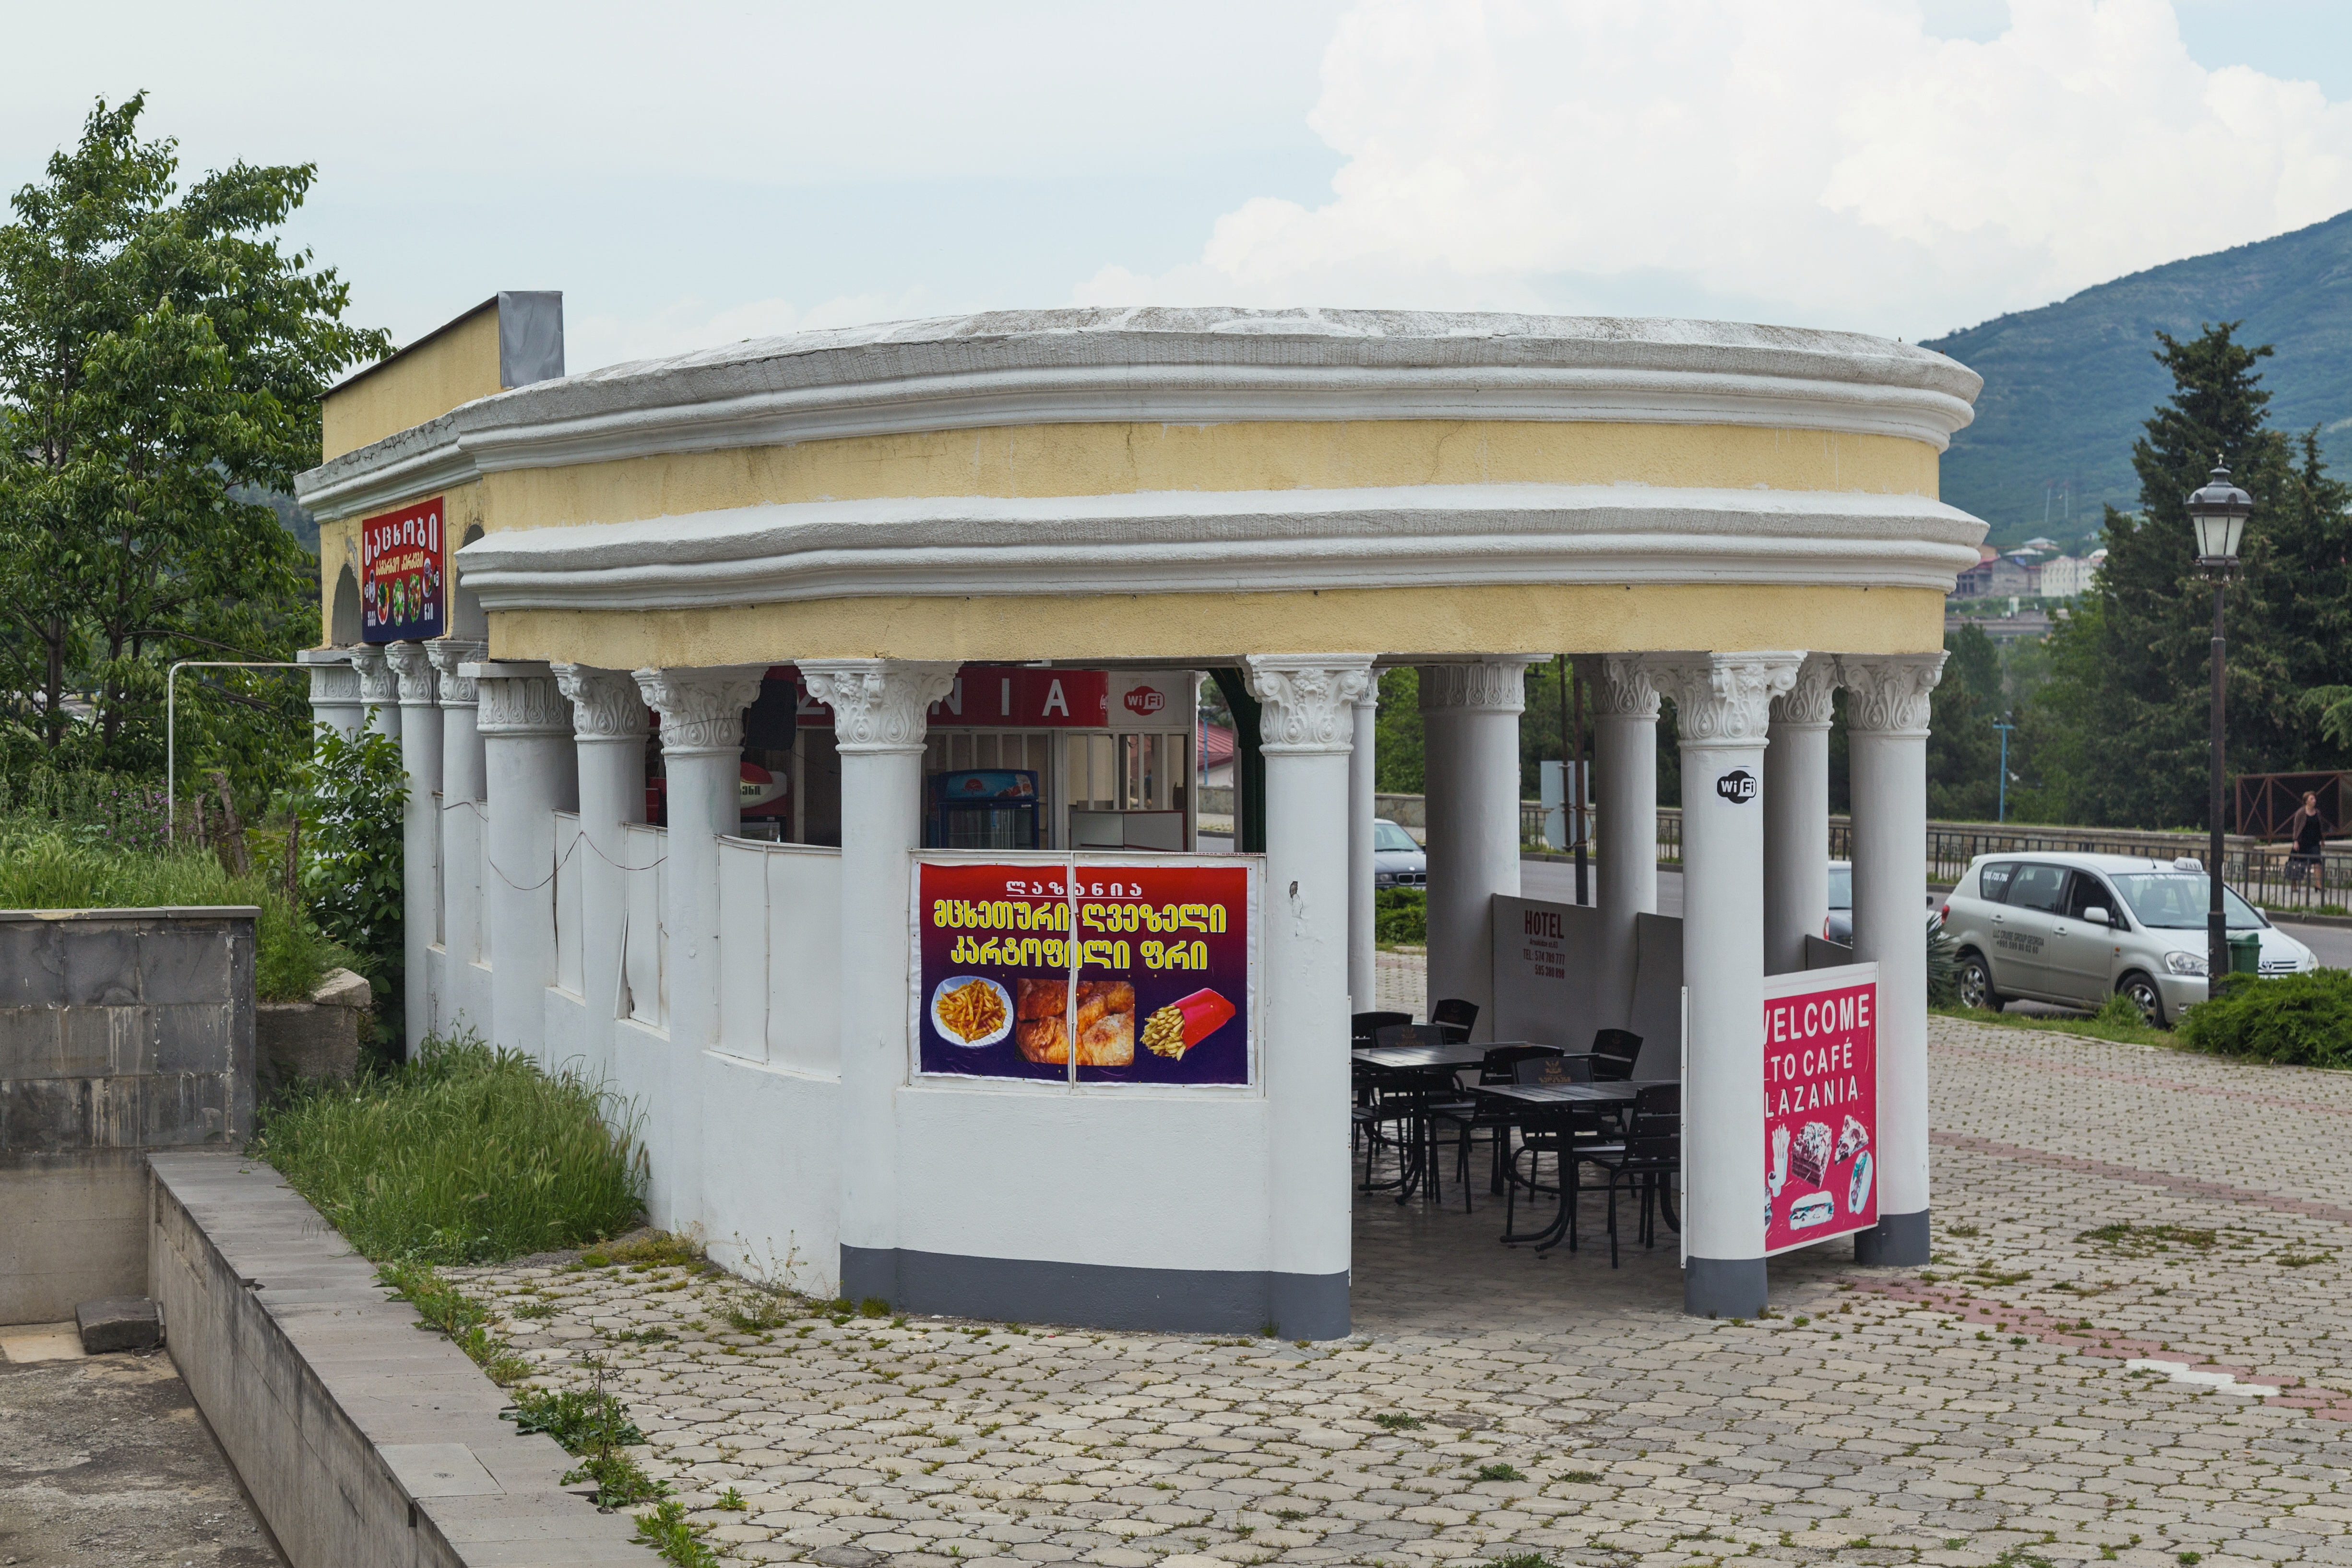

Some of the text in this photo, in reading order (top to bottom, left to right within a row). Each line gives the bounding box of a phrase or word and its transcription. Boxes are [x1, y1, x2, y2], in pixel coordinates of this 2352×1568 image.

[365, 513, 437, 567] საცხობი
[376, 551, 424, 576] სამარხვო კერძები
[424, 603, 433, 620] ჩაი
[2185, 862, 2200, 870] TAXI
[1006, 881, 1142, 896] ლაზანია
[934, 899, 1227, 933] მცხეთური ღვეზელი
[1525, 910, 1564, 939] HOTEL
[2014, 932, 2027, 943] GROUP
[2028, 935, 2044, 946] GEORGIA
[951, 936, 1208, 970] კარტოფილი ფრი
[1535, 950, 1544, 962] 574
[1556, 953, 1565, 965] 777
[1770, 1037, 1852, 1082] TO CAFÉ
[1766, 1075, 1858, 1118] LAZANIA
